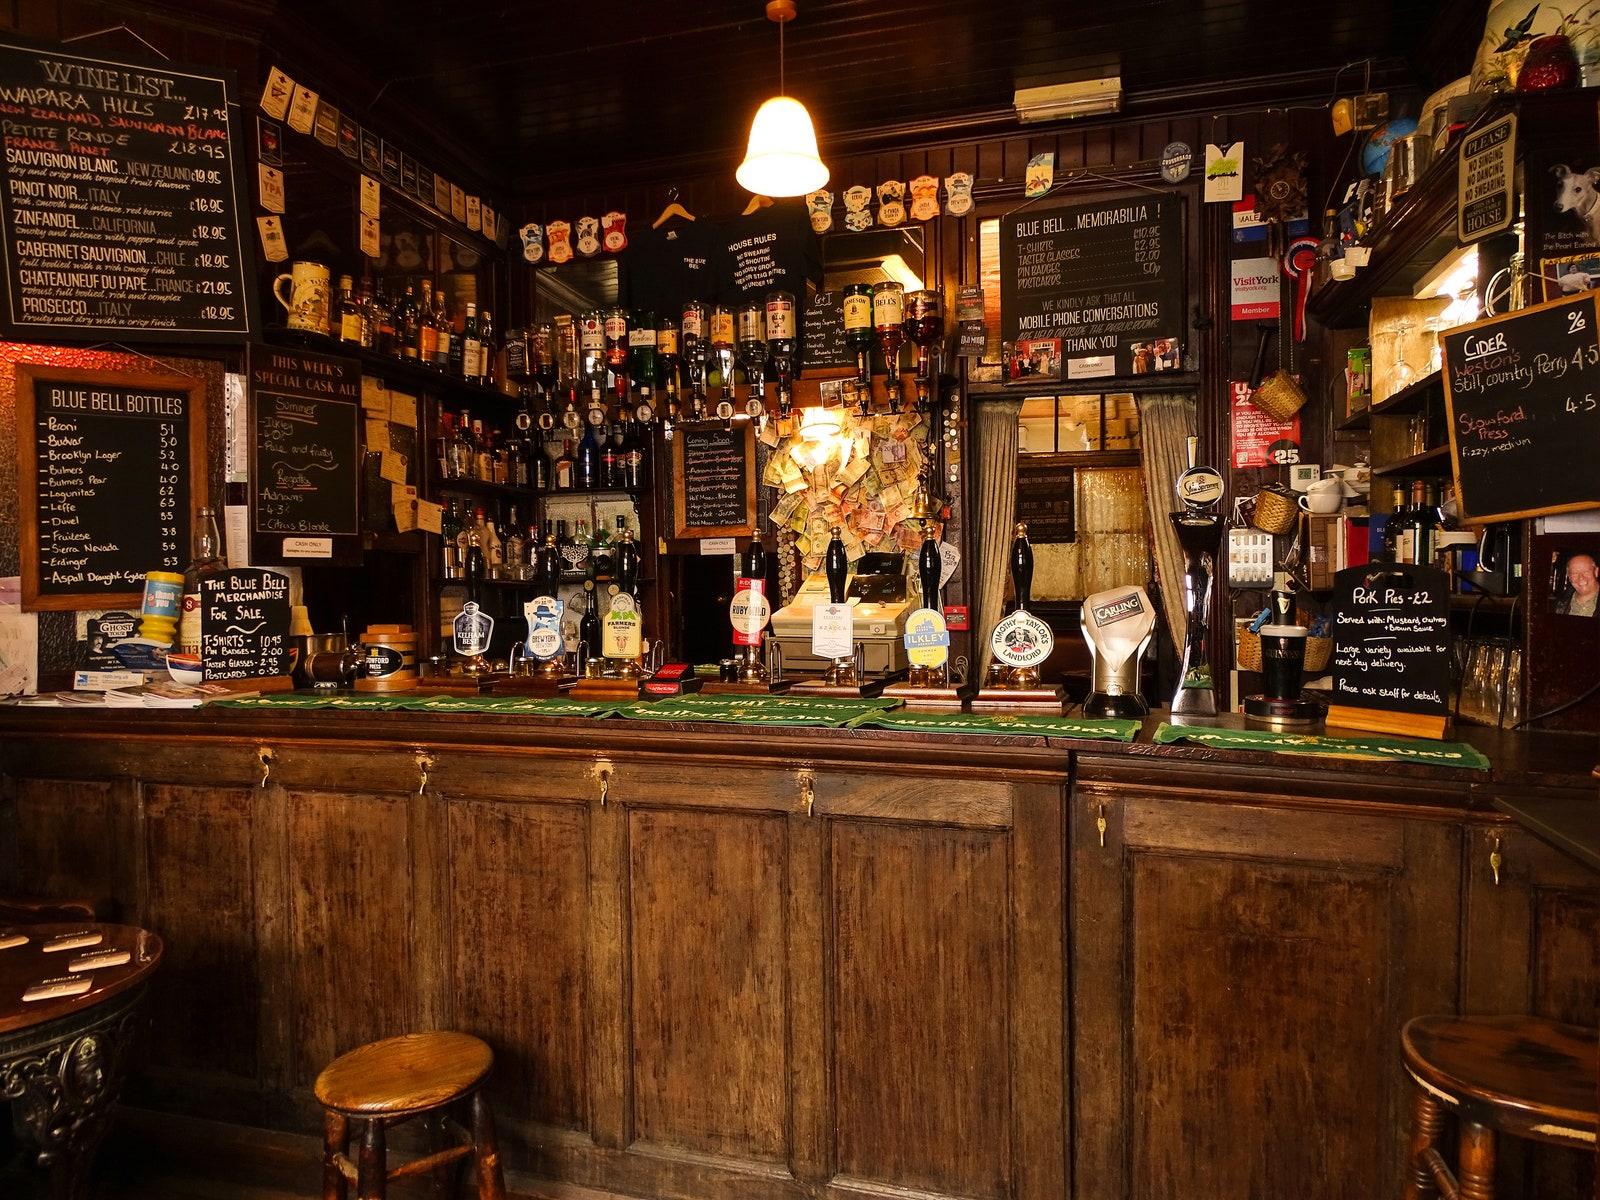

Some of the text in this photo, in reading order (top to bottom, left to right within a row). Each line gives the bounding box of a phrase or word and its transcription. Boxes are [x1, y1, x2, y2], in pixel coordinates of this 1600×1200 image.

[0, 87, 227, 122] WAIPARA HILLS £17.95
[1, 119, 131, 146] PETITE RONDE
[187, 124, 227, 141] BLANC
[1468, 126, 1508, 155] PLEASE
[168, 142, 225, 159] £18.95
[6, 148, 78, 170] SAUVIGNON
[127, 161, 150, 177] NEW
[152, 164, 191, 182] ZEALAND
[1468, 158, 1478, 173] NO
[1467, 160, 1504, 187] NO DANCING
[263, 181, 282, 197] YPA
[1465, 174, 1506, 201] NO SWEARING
[10, 179, 224, 214] PINOT ITALY £16.95
[1016, 205, 1148, 238] BLUE MEMORABILIA
[1467, 207, 1501, 234] HOUSE
[93, 217, 226, 241] CALIFORNIA £18.95
[728, 233, 777, 252] HOUSE RULES
[16, 240, 230, 269] CABERNET CHILE £18.95
[20, 270, 232, 296] CHATEAUNEUF DU FRANCE £21.95
[1042, 293, 1121, 311] WE KINDLY THAT
[99, 302, 235, 321] ITALY £18.95
[1019, 302, 1159, 330] MOBILE PHONE CONVERSATIONS
[1241, 307, 1270, 315] Member
[1066, 335, 1118, 352] THANK YOU
[1463, 332, 1508, 357] CIDER
[272, 355, 343, 378] THIS WEEK'S
[1534, 352, 1569, 380] Perry
[255, 370, 334, 393] SPECIAL CASK
[52, 389, 183, 416] BLUE BELL BOTTLES
[48, 417, 77, 431] Peroni
[48, 434, 84, 447] Budvar
[1478, 427, 1509, 441] Press
[1491, 436, 1532, 452] medium
[48, 450, 122, 464] Brooklyn Lager
[1274, 449, 1300, 465] 25
[49, 464, 83, 475] Bulmers
[49, 475, 107, 487] Bulmers Pear
[49, 488, 95, 503] Lagunitas
[51, 503, 77, 513] Leffe
[51, 516, 80, 526] Duvel
[52, 543, 119, 554] Sierra Nevada
[50, 557, 89, 571] Erdinger
[52, 571, 84, 585] Aspall
[204, 573, 287, 591] THE BLUE BELL
[215, 590, 283, 603] MERCHANDISE
[1384, 588, 1404, 605] Pies
[210, 607, 228, 621] FOR
[732, 605, 749, 615] RUBY
[1096, 599, 1138, 619] CARLING
[1336, 612, 1365, 625] Served
[100, 622, 134, 633] GHOST
[995, 619, 1049, 645] TIMOTHY TAYLOR'S
[203, 634, 244, 648] T-SHIRTS
[462, 637, 478, 645] BEST
[908, 633, 944, 644] ILKLEY
[205, 646, 218, 656] PIN
[221, 646, 250, 656] BADGES
[1002, 648, 1042, 662] LANDLORD
[1336, 642, 1447, 660] Large variety available for
[203, 657, 227, 669] TASTER
[228, 659, 254, 668] GLASSES
[1335, 658, 1352, 666] next
[1353, 658, 1368, 672] day
[205, 668, 247, 680] POSTCARDS
[1339, 678, 1359, 694] Please
[1362, 687, 1377, 696] ask
[1379, 688, 1400, 699] staff
[1401, 689, 1411, 699] for
